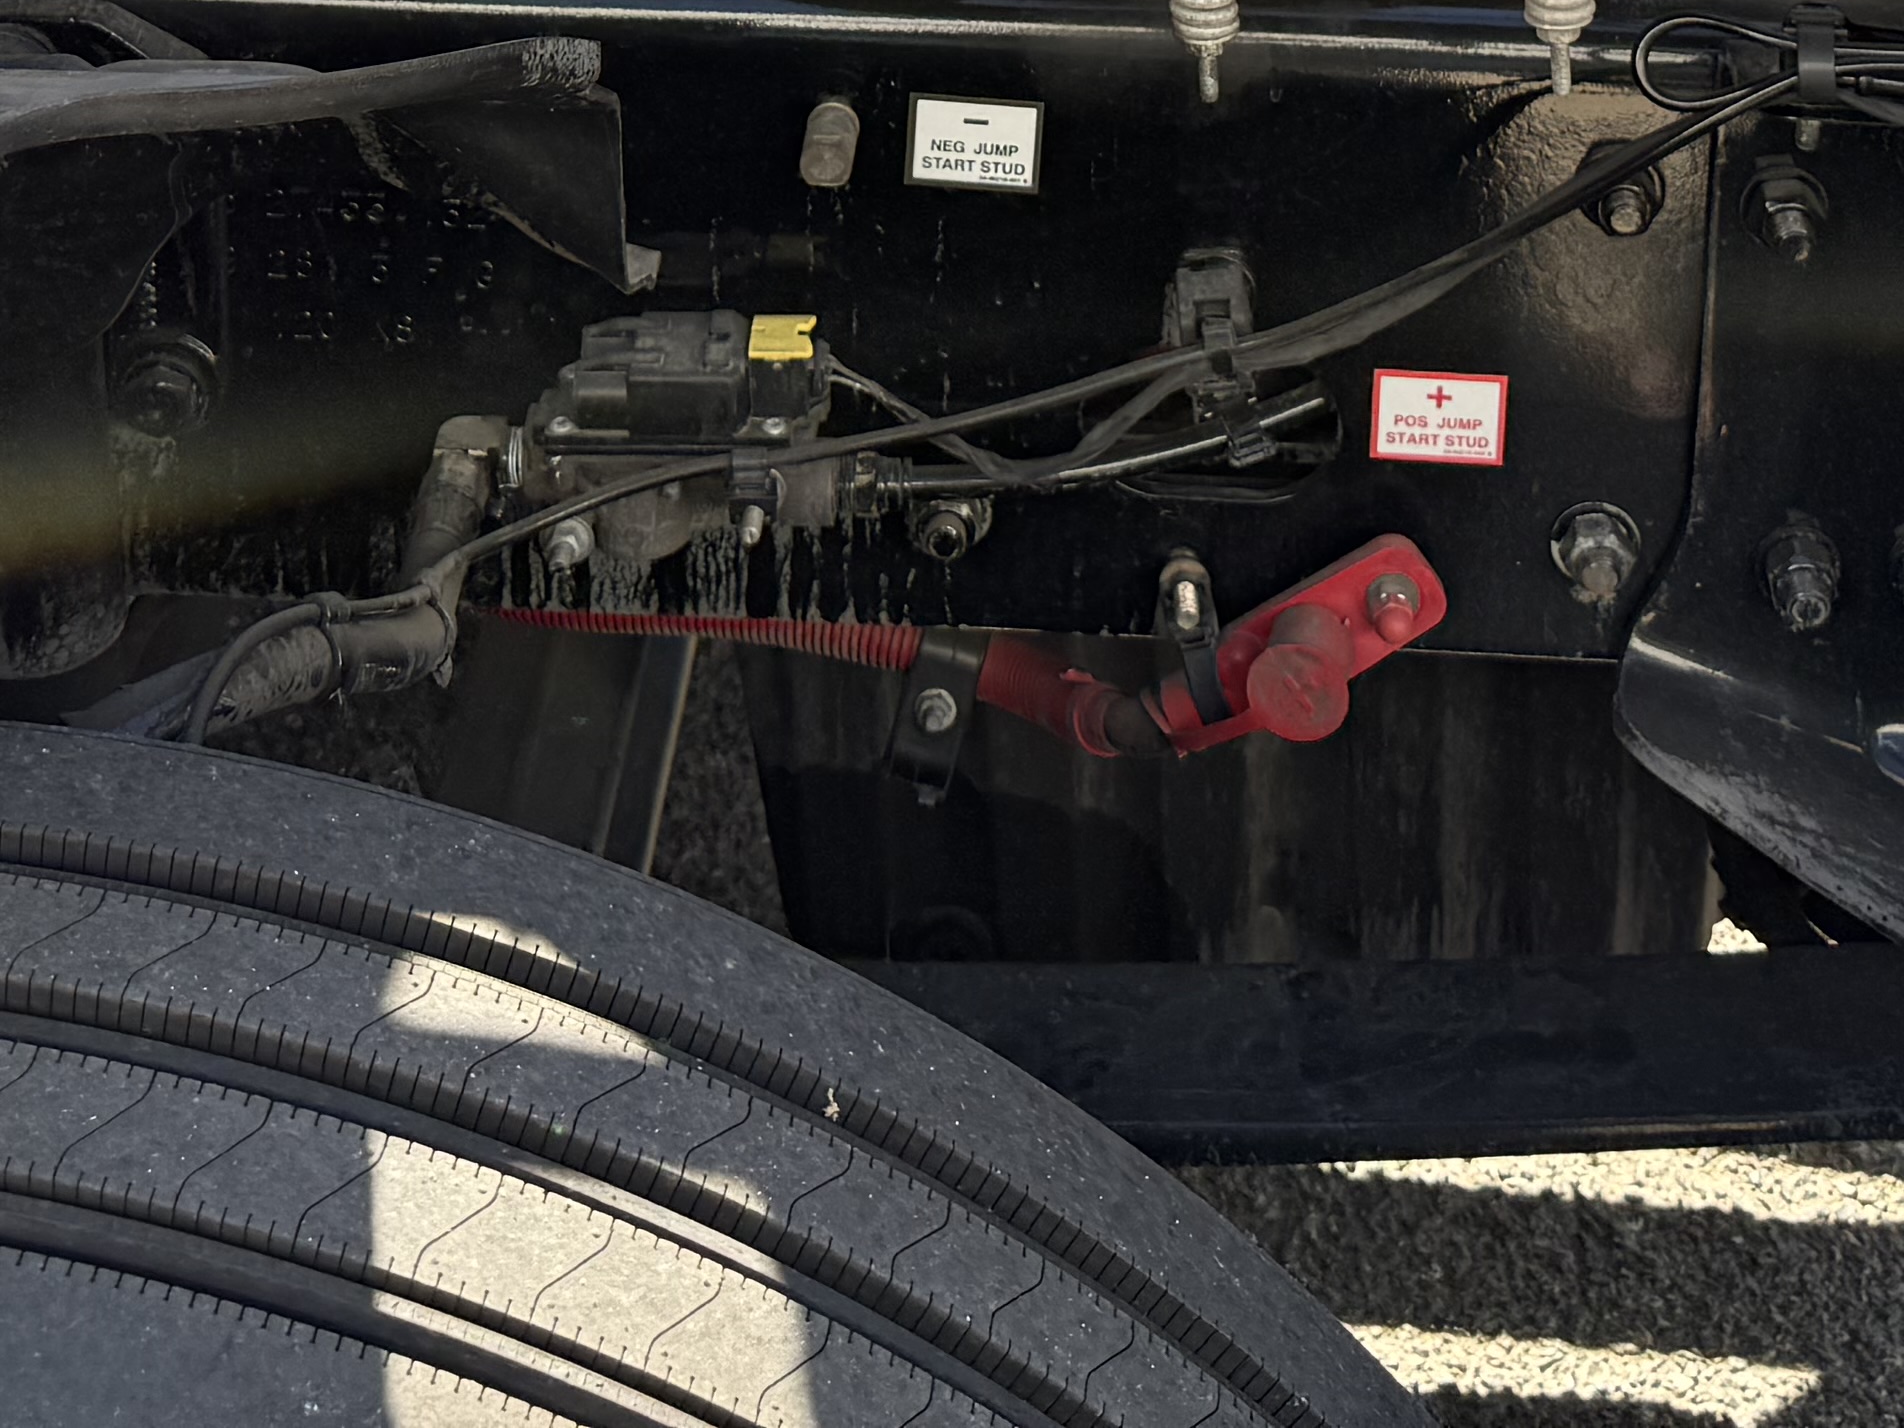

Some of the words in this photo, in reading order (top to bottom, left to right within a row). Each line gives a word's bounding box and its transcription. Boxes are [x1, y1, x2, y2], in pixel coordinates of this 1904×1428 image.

[930, 138, 966, 154] NEG
[973, 142, 1019, 157] JUMP
[922, 156, 976, 172] START
[980, 160, 1026, 176] STUD
[1393, 414, 1429, 428] POS
[1436, 417, 1483, 431] JUMP
[1385, 431, 1440, 447] START
[1444, 435, 1489, 449] STUD
